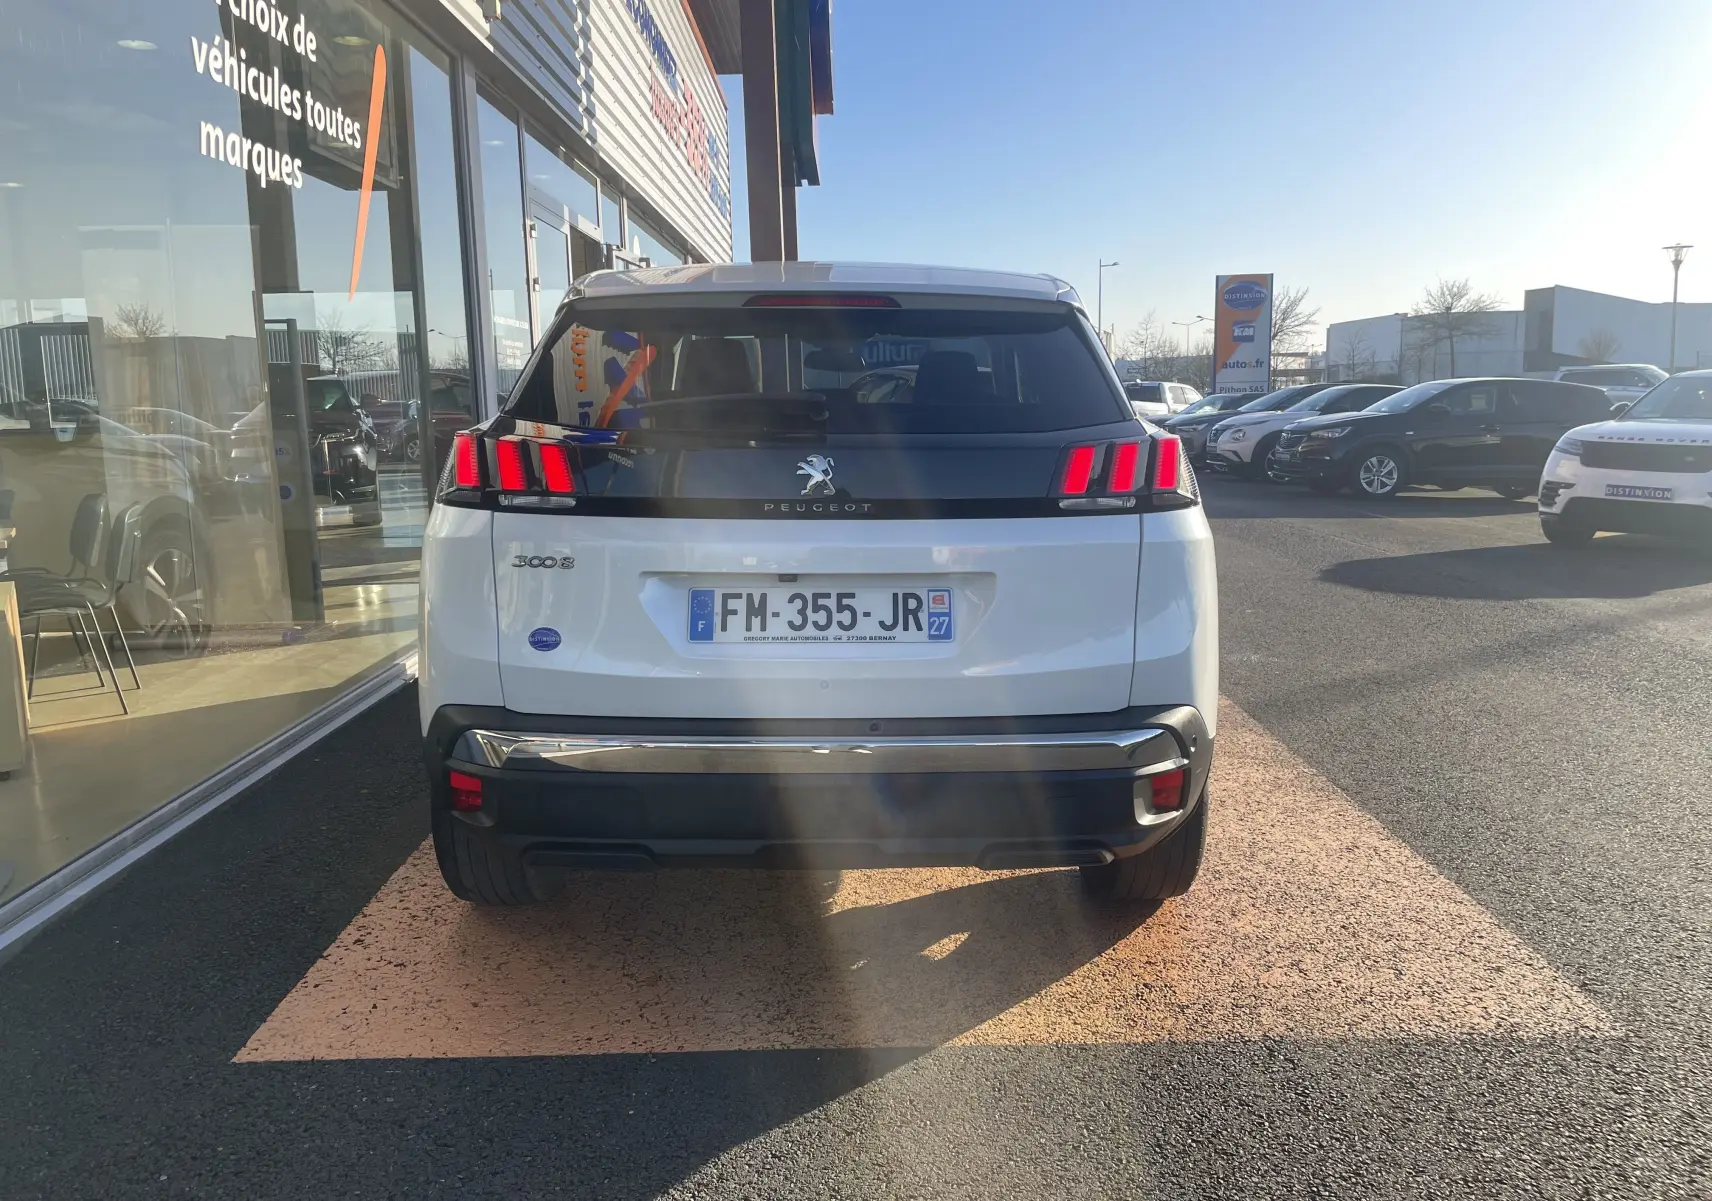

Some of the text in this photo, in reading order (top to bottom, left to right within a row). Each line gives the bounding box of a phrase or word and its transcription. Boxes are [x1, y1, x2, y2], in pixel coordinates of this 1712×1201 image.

[293, 14, 317, 62] de
[191, 34, 362, 149] véhicules toutes
[200, 121, 303, 189] marques
[1221, 358, 1265, 369] autos.fr
[1220, 385, 1265, 394] Pithon SAS
[1655, 437, 1711, 445] ROVER
[1605, 487, 1672, 499] DISTINXION
[764, 503, 872, 512] PEUGEOT
[511, 554, 575, 569] 3008
[720, 592, 950, 635] FM-355-JR 27
[698, 621, 705, 632] F
